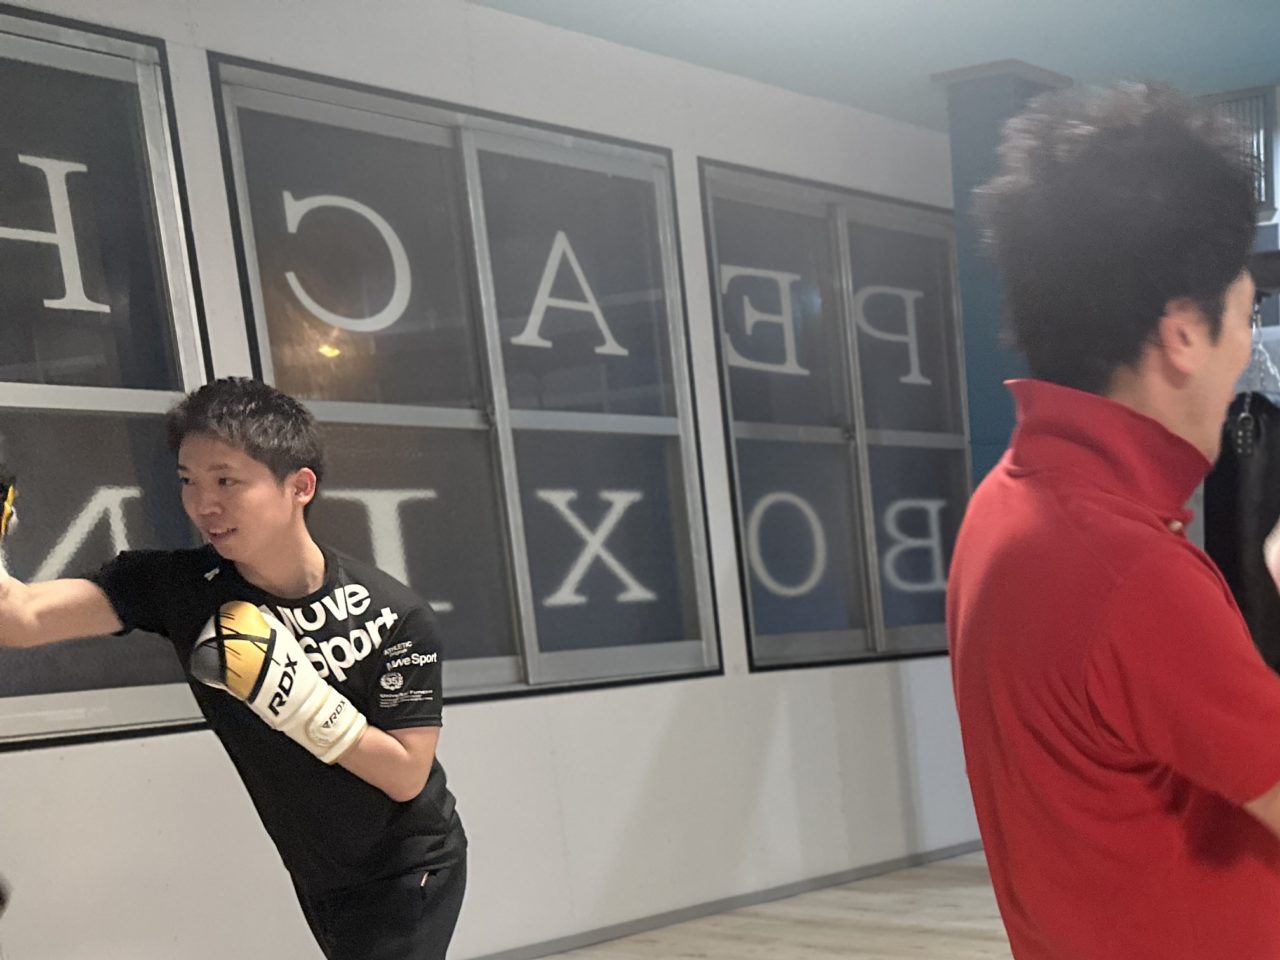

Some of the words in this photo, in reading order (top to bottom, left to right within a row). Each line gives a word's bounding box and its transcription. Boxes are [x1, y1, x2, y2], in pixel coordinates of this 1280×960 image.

[300, 607, 398, 682] Sport
[411, 652, 437, 667] Sport
[268, 652, 298, 717] RDX
[329, 700, 346, 724] RDX
